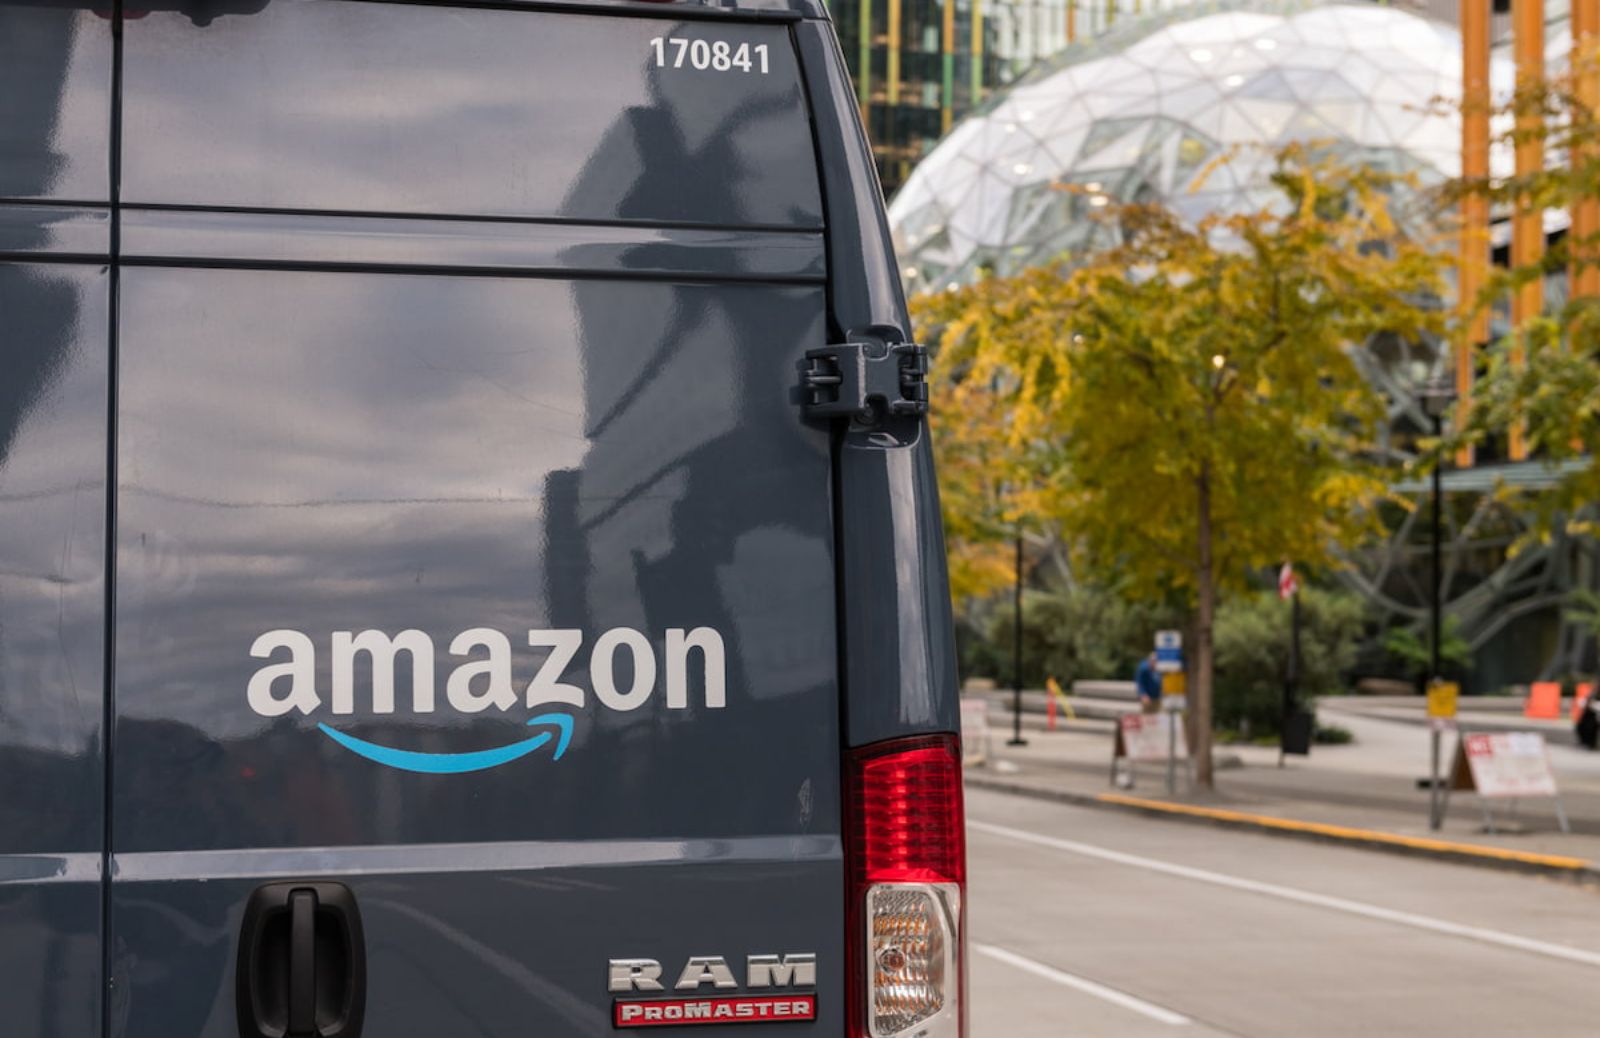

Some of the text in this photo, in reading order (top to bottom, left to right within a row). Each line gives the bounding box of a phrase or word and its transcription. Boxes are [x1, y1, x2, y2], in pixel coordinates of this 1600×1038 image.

[650, 37, 769, 74] 170841
[247, 627, 727, 717] amazon
[608, 953, 816, 991] RAM
